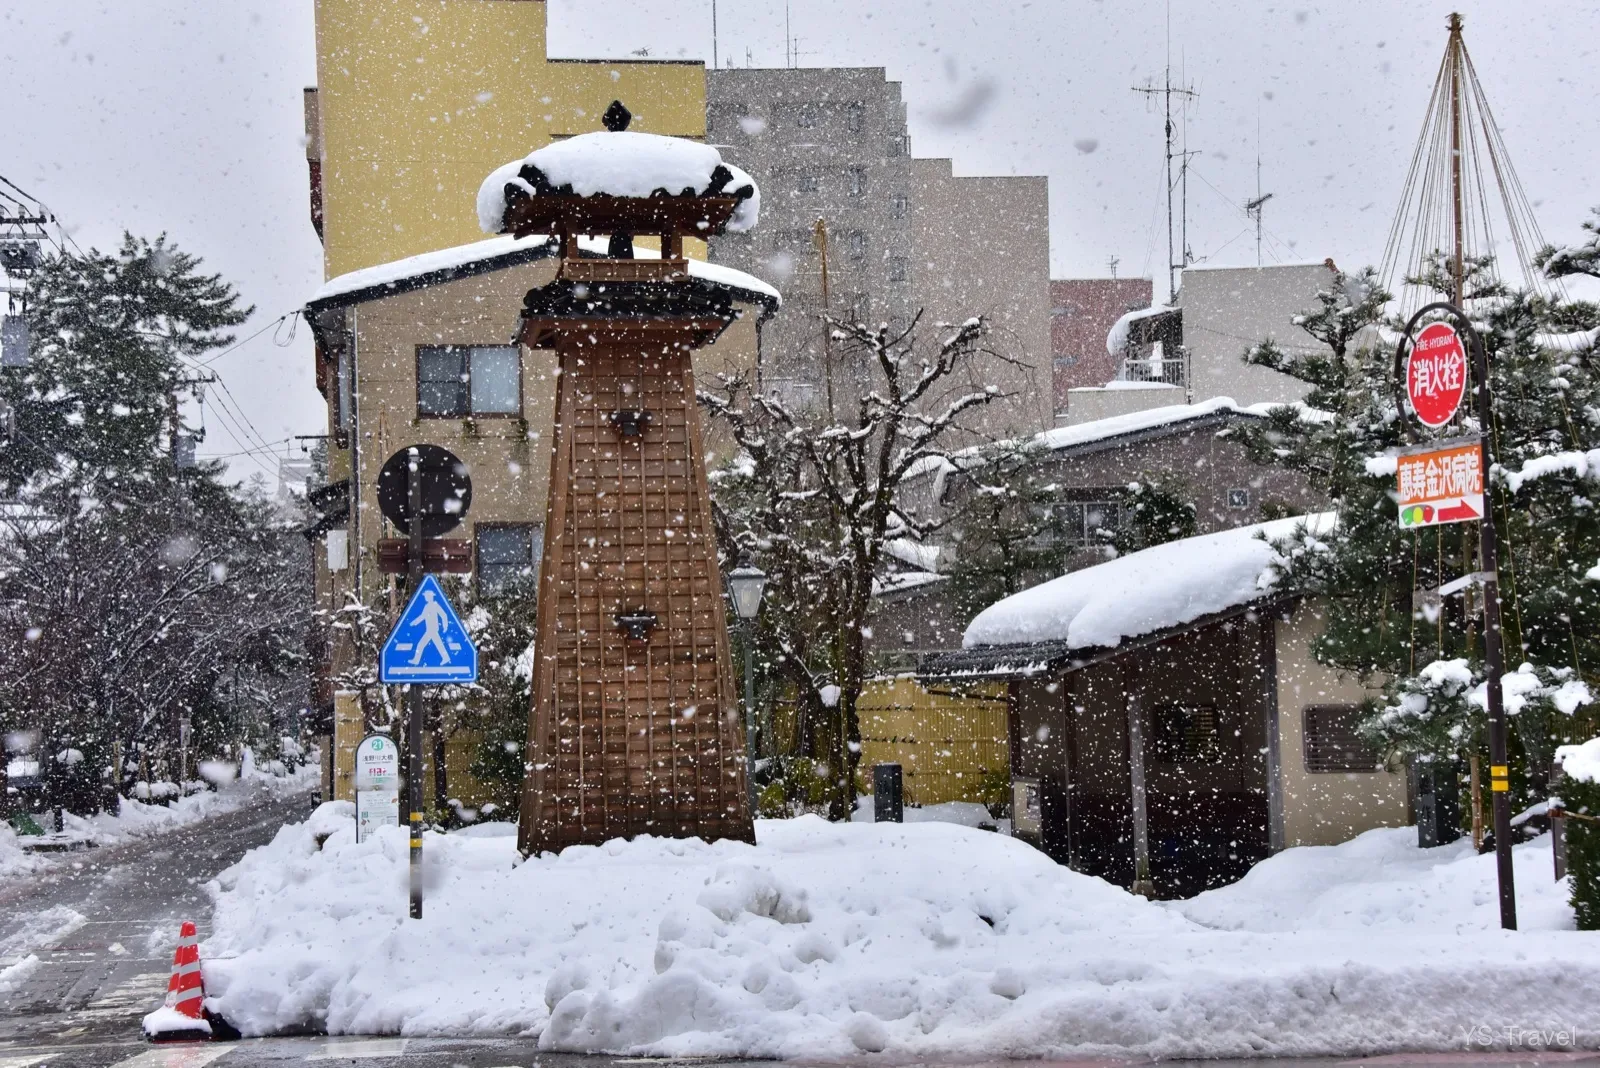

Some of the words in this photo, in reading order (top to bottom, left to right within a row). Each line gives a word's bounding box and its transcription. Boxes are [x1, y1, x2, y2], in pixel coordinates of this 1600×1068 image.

[1416, 339, 1429, 353] FIRE
[1429, 334, 1455, 350] HYDRANT
[1413, 349, 1461, 397] 消火栓
